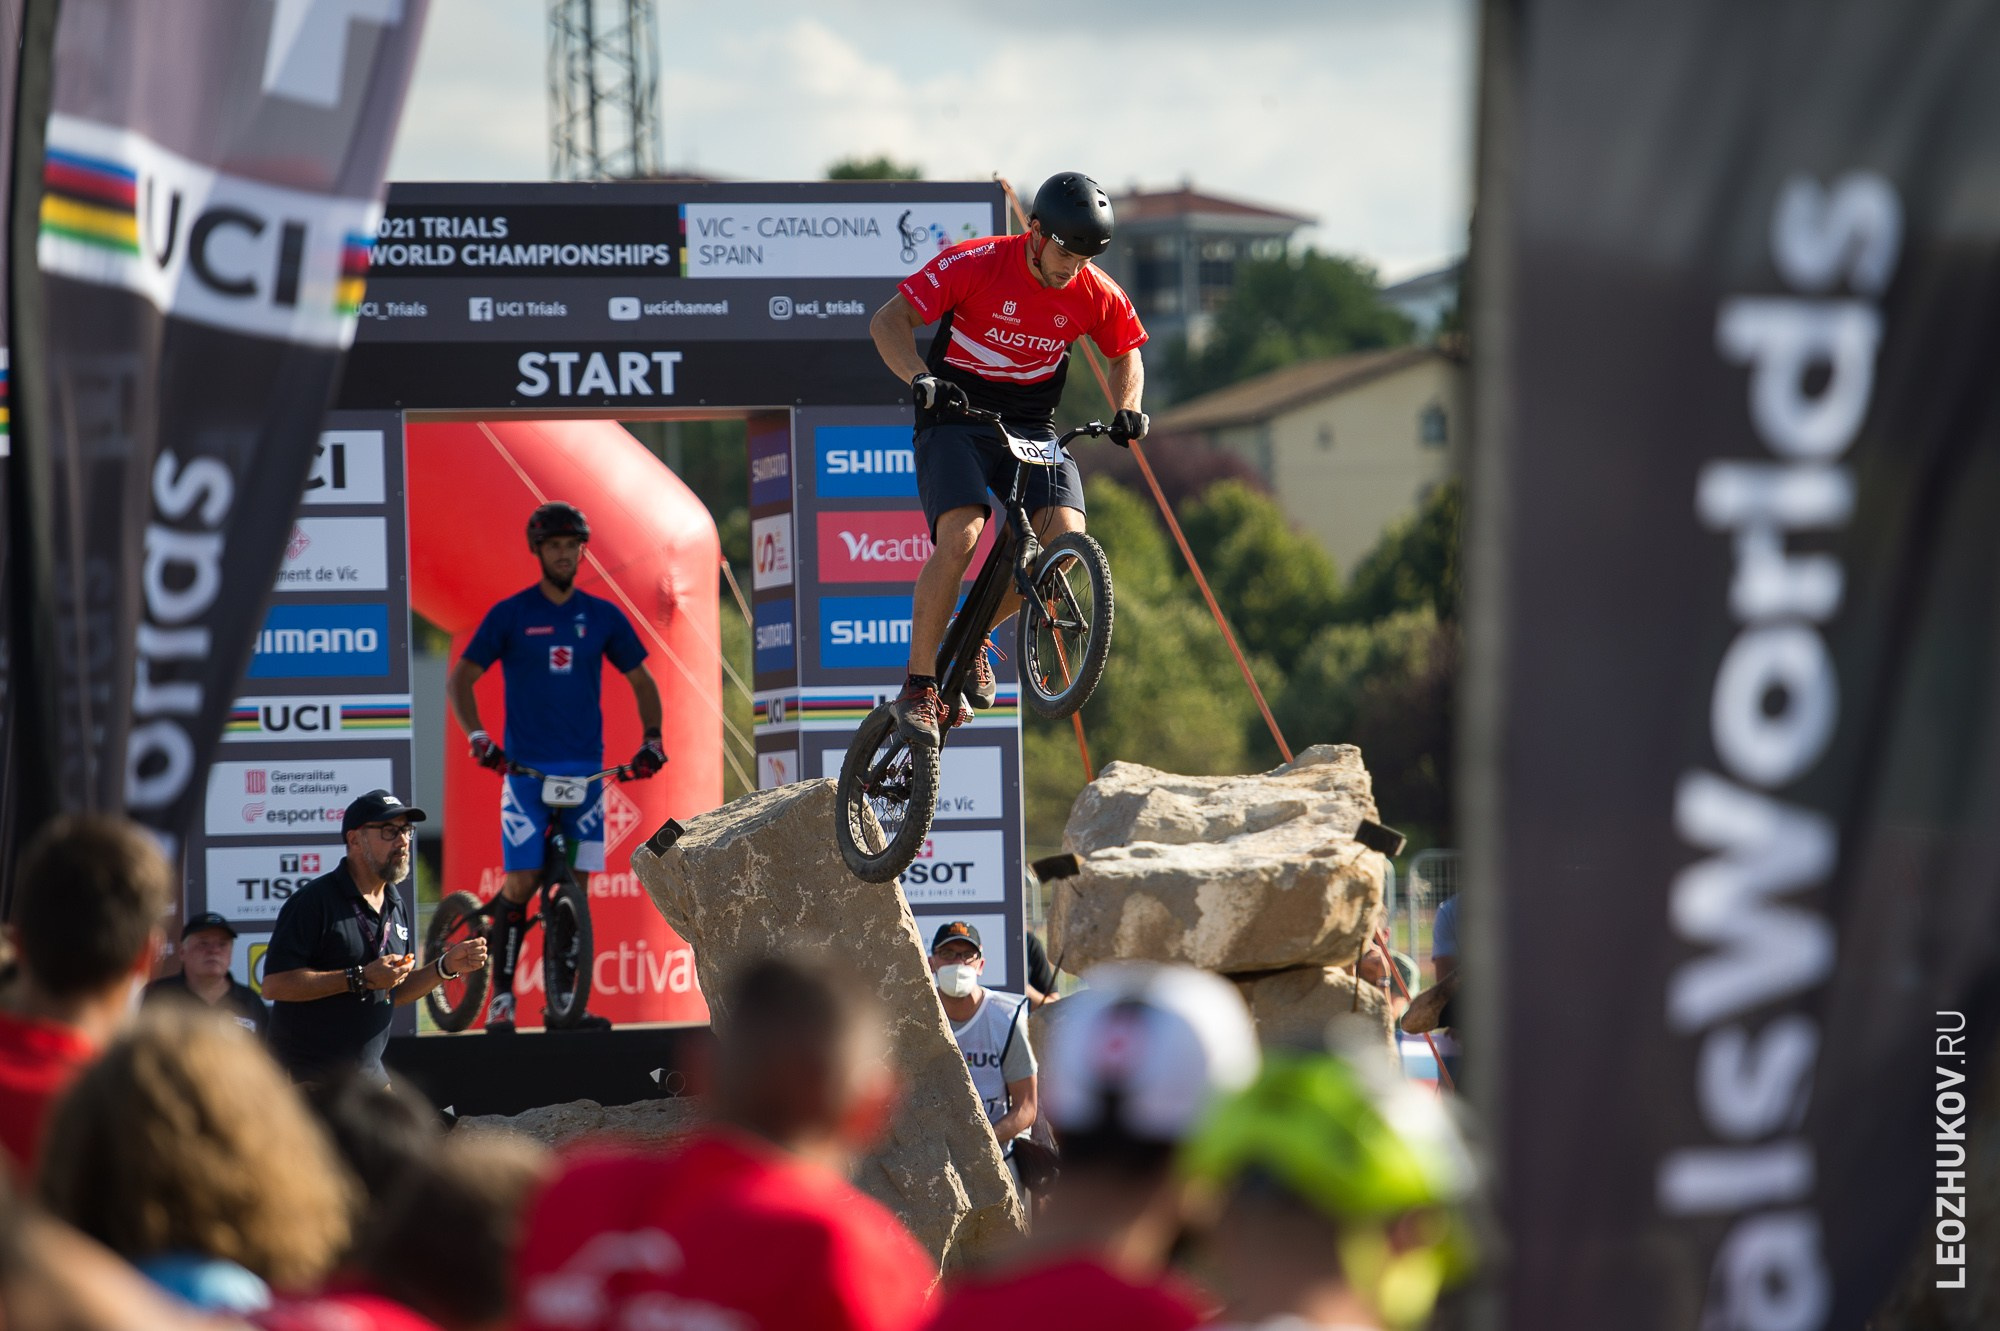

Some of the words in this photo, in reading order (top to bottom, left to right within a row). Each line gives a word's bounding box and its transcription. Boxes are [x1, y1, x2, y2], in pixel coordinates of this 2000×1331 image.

[375, 217, 415, 238] 021
[420, 217, 508, 238] TRIALS
[697, 217, 734, 238] VIC
[757, 216, 880, 237] CATALONIA
[145, 175, 307, 308] UCI
[367, 244, 455, 266] WORLD
[461, 244, 670, 266] CHAMPIONSHIPS
[699, 245, 763, 265] SPAIN
[496, 303, 523, 317] UCI
[527, 302, 568, 317] Trials
[643, 299, 729, 316] ucichannel
[795, 300, 865, 319] uci_trials
[992, 312, 1021, 324] Husqvarna
[984, 327, 1065, 351] AUSTRIA
[516, 351, 682, 396] START
[751, 452, 788, 483] SHIMANO
[315, 566, 333, 582] de
[337, 565, 359, 582] Vic
[756, 621, 792, 651] SHIMANO
[263, 704, 331, 731] UCI
[766, 698, 785, 726] UCI
[271, 769, 335, 782] Generalitat
[271, 784, 286, 795] de
[289, 783, 349, 796] Catalunya
[554, 786, 578, 799] 9C
[954, 795, 975, 811] Vic
[899, 861, 975, 885] SOT
